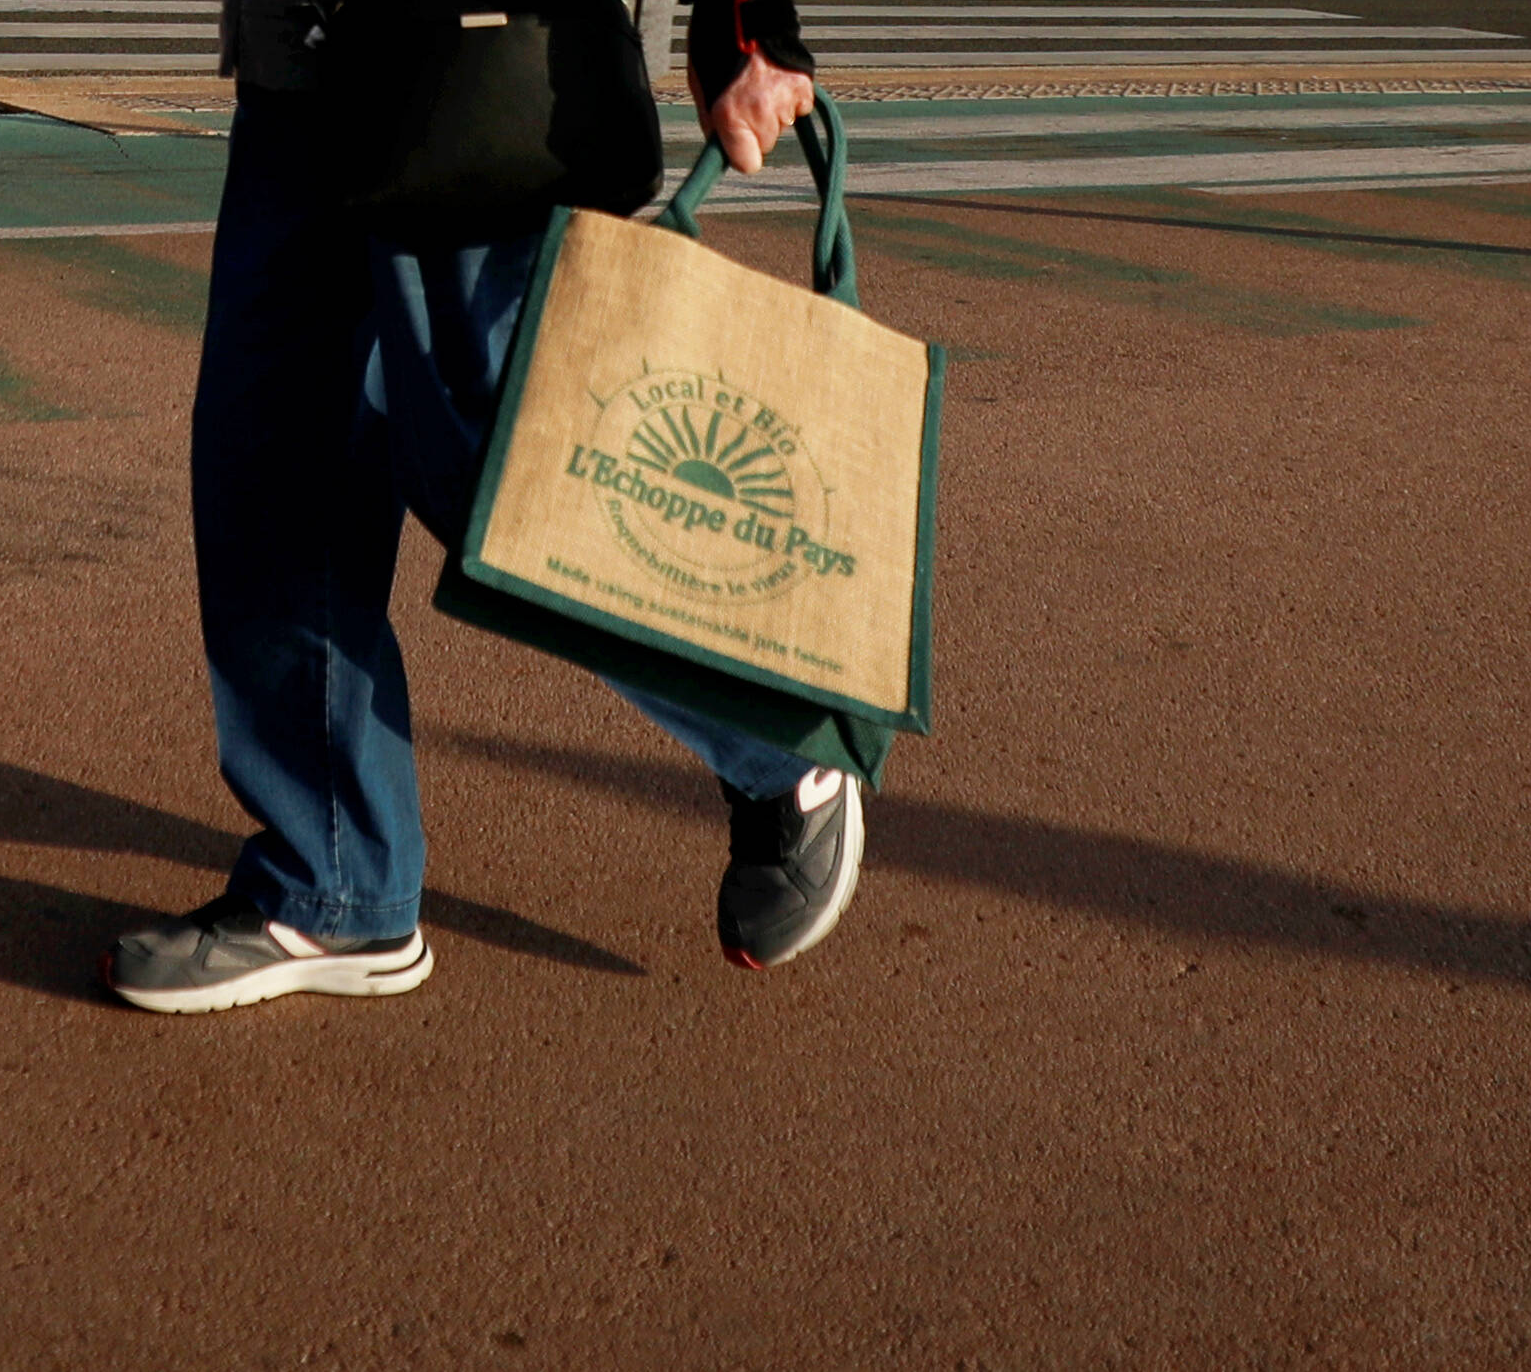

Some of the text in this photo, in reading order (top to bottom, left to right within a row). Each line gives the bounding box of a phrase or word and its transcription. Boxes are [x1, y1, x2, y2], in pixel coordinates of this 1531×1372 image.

[628, 374, 798, 455] Local et Bio
[565, 443, 857, 578] L'Echoppe du Pays
